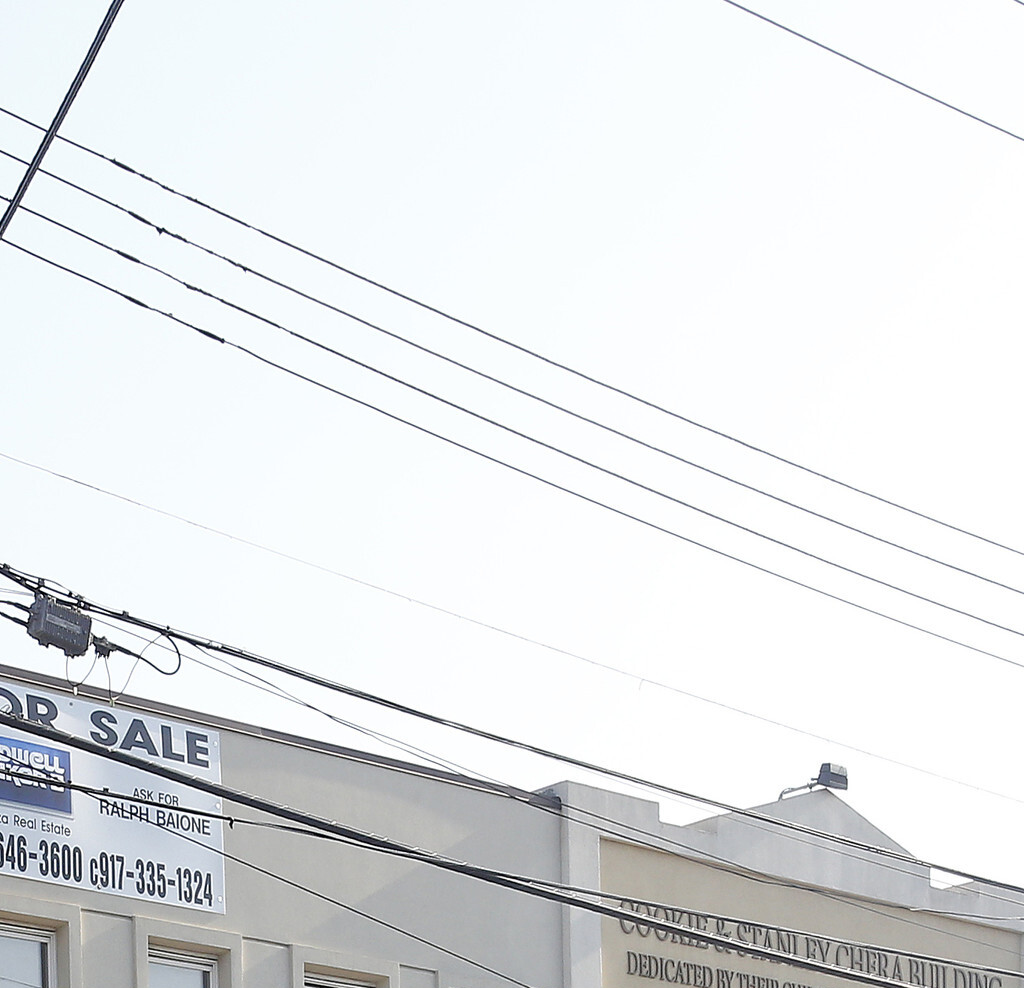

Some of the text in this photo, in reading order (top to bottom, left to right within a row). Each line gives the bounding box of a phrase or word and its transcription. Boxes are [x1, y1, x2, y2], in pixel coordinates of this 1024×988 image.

[89, 710, 210, 769] SALE
[133, 788, 180, 806] ASK FOR
[13, 814, 37, 830] Real
[41, 819, 71, 837] Estate
[99, 800, 211, 836] RALPH BAIONE
[89, 852, 213, 907] c917-335-1324
